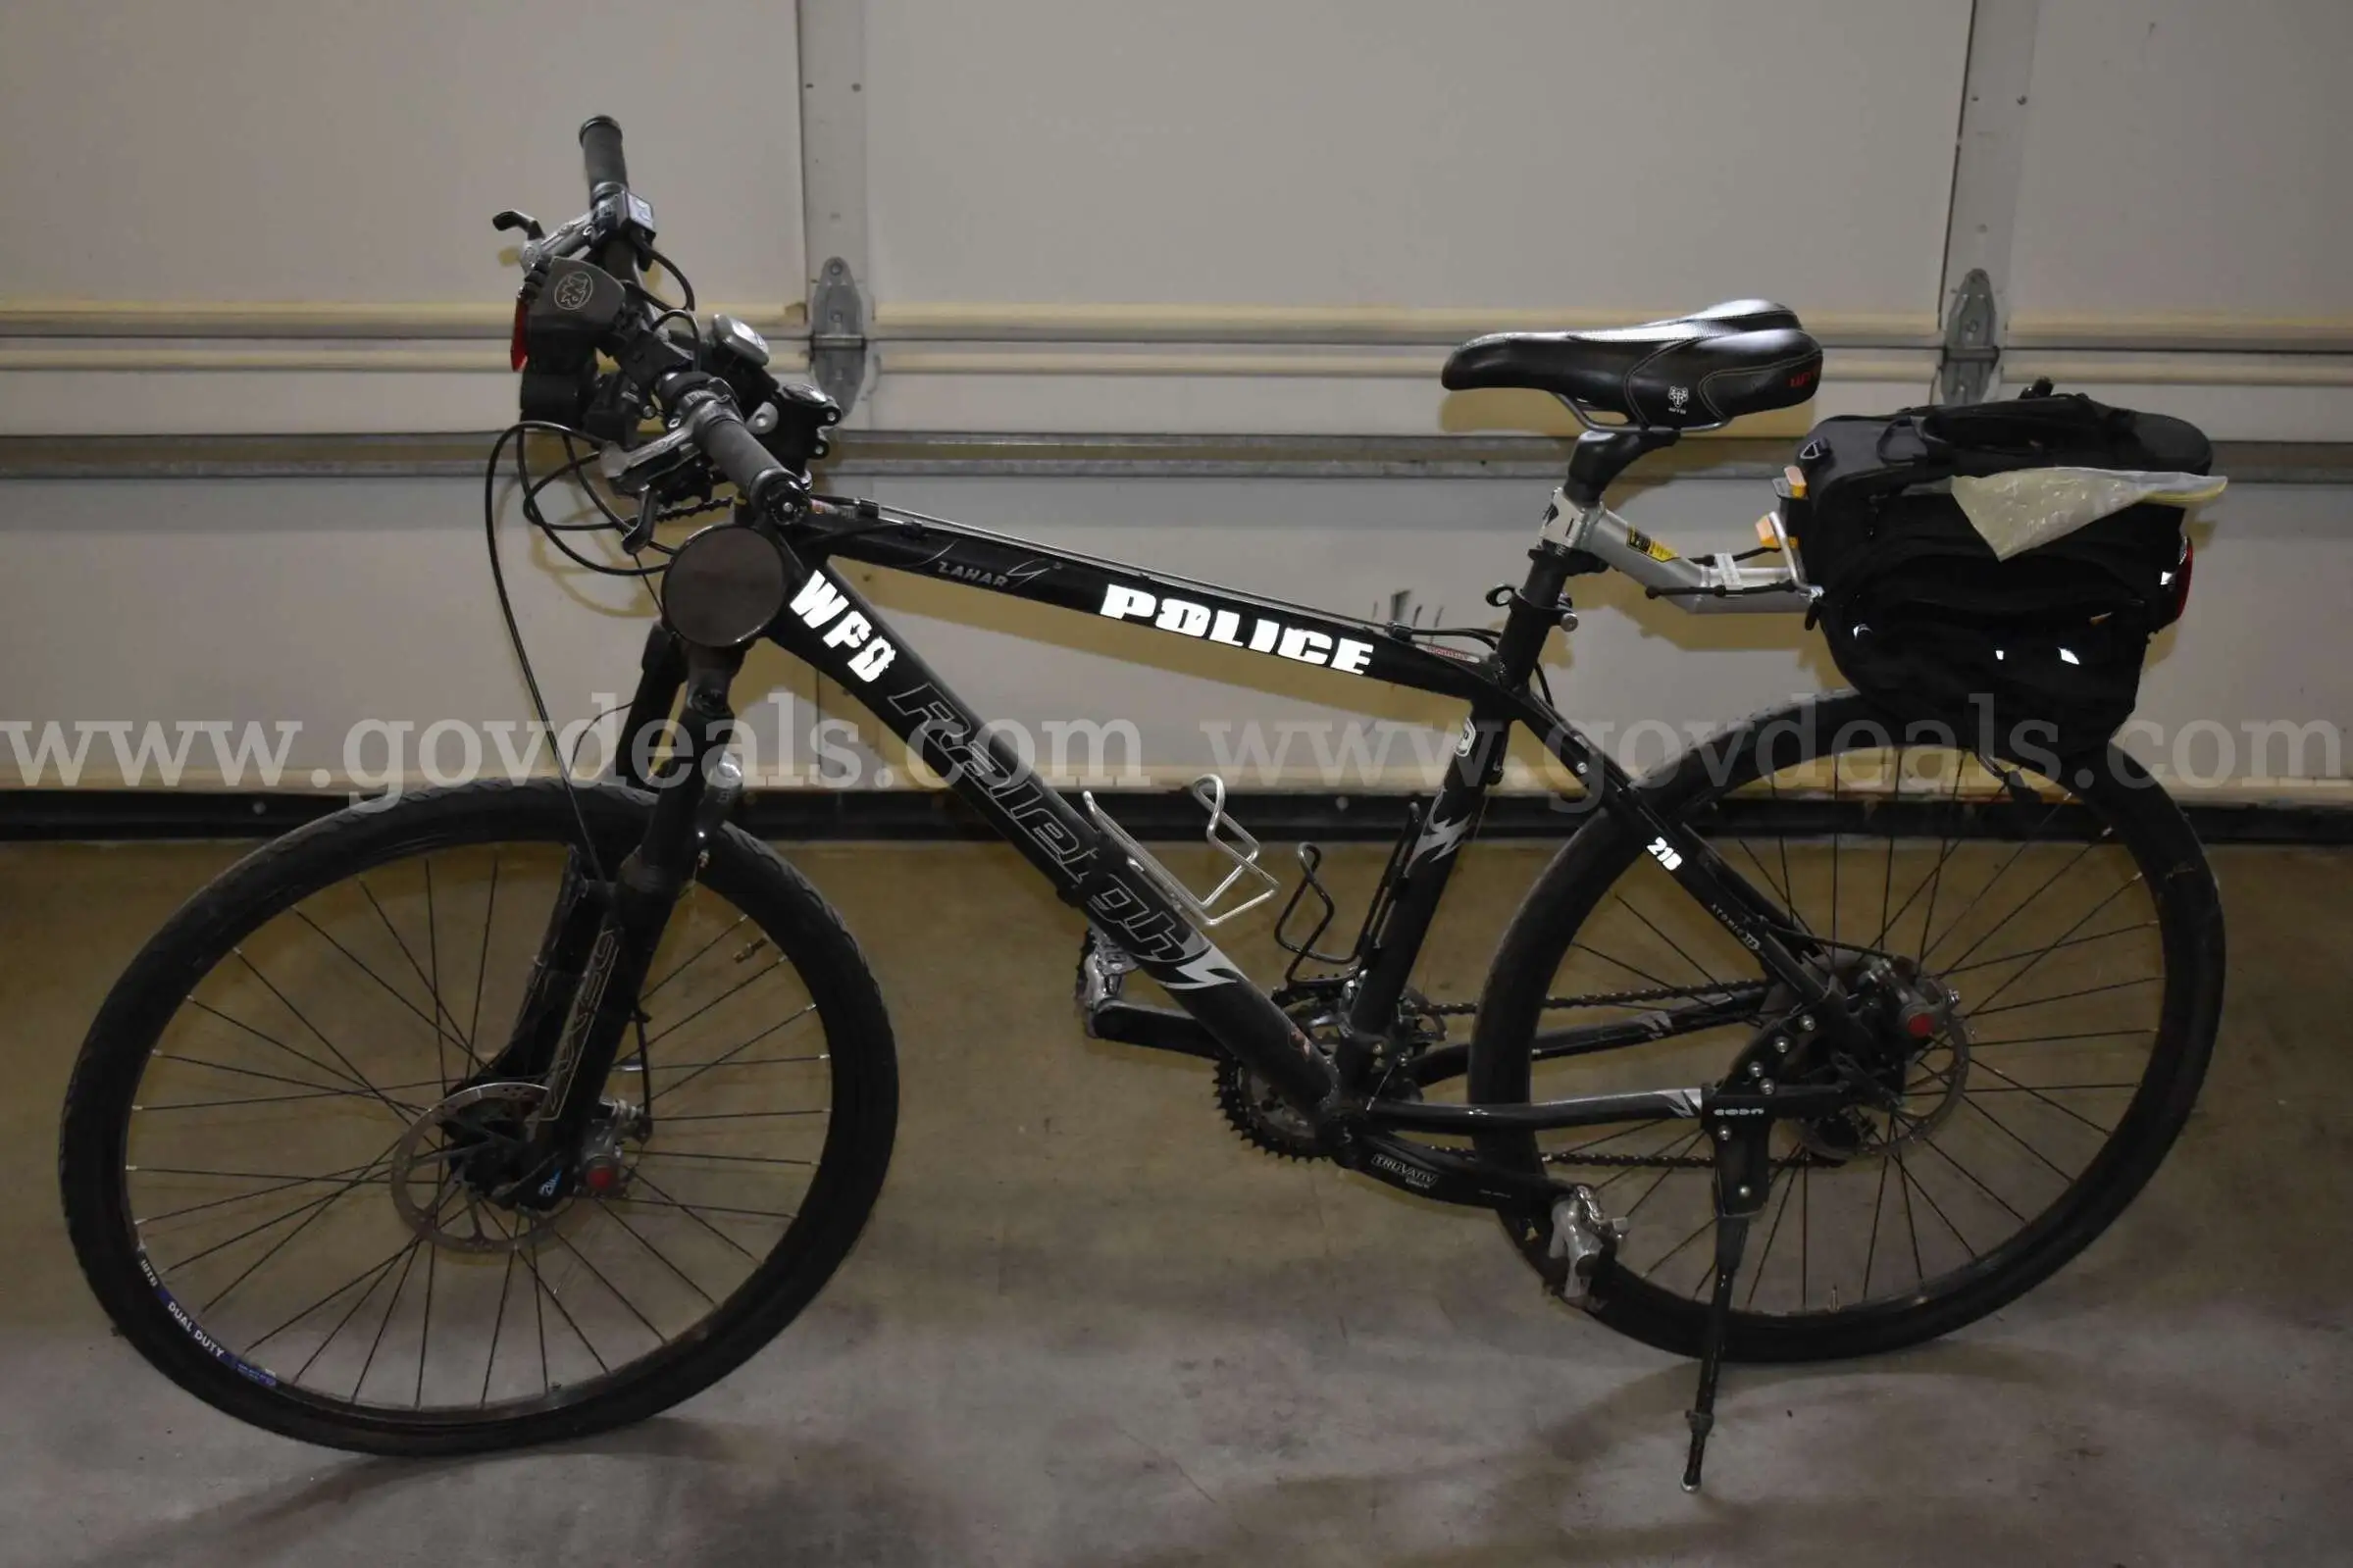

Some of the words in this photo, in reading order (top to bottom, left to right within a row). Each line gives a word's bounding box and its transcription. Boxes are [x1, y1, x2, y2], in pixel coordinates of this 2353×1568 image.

[937, 560, 1009, 587] ZAHAR
[790, 569, 896, 683] WPD
[1099, 583, 1374, 675] POLICE
[168, 1301, 193, 1332] DUAL
[194, 1330, 225, 1358] DUTY
